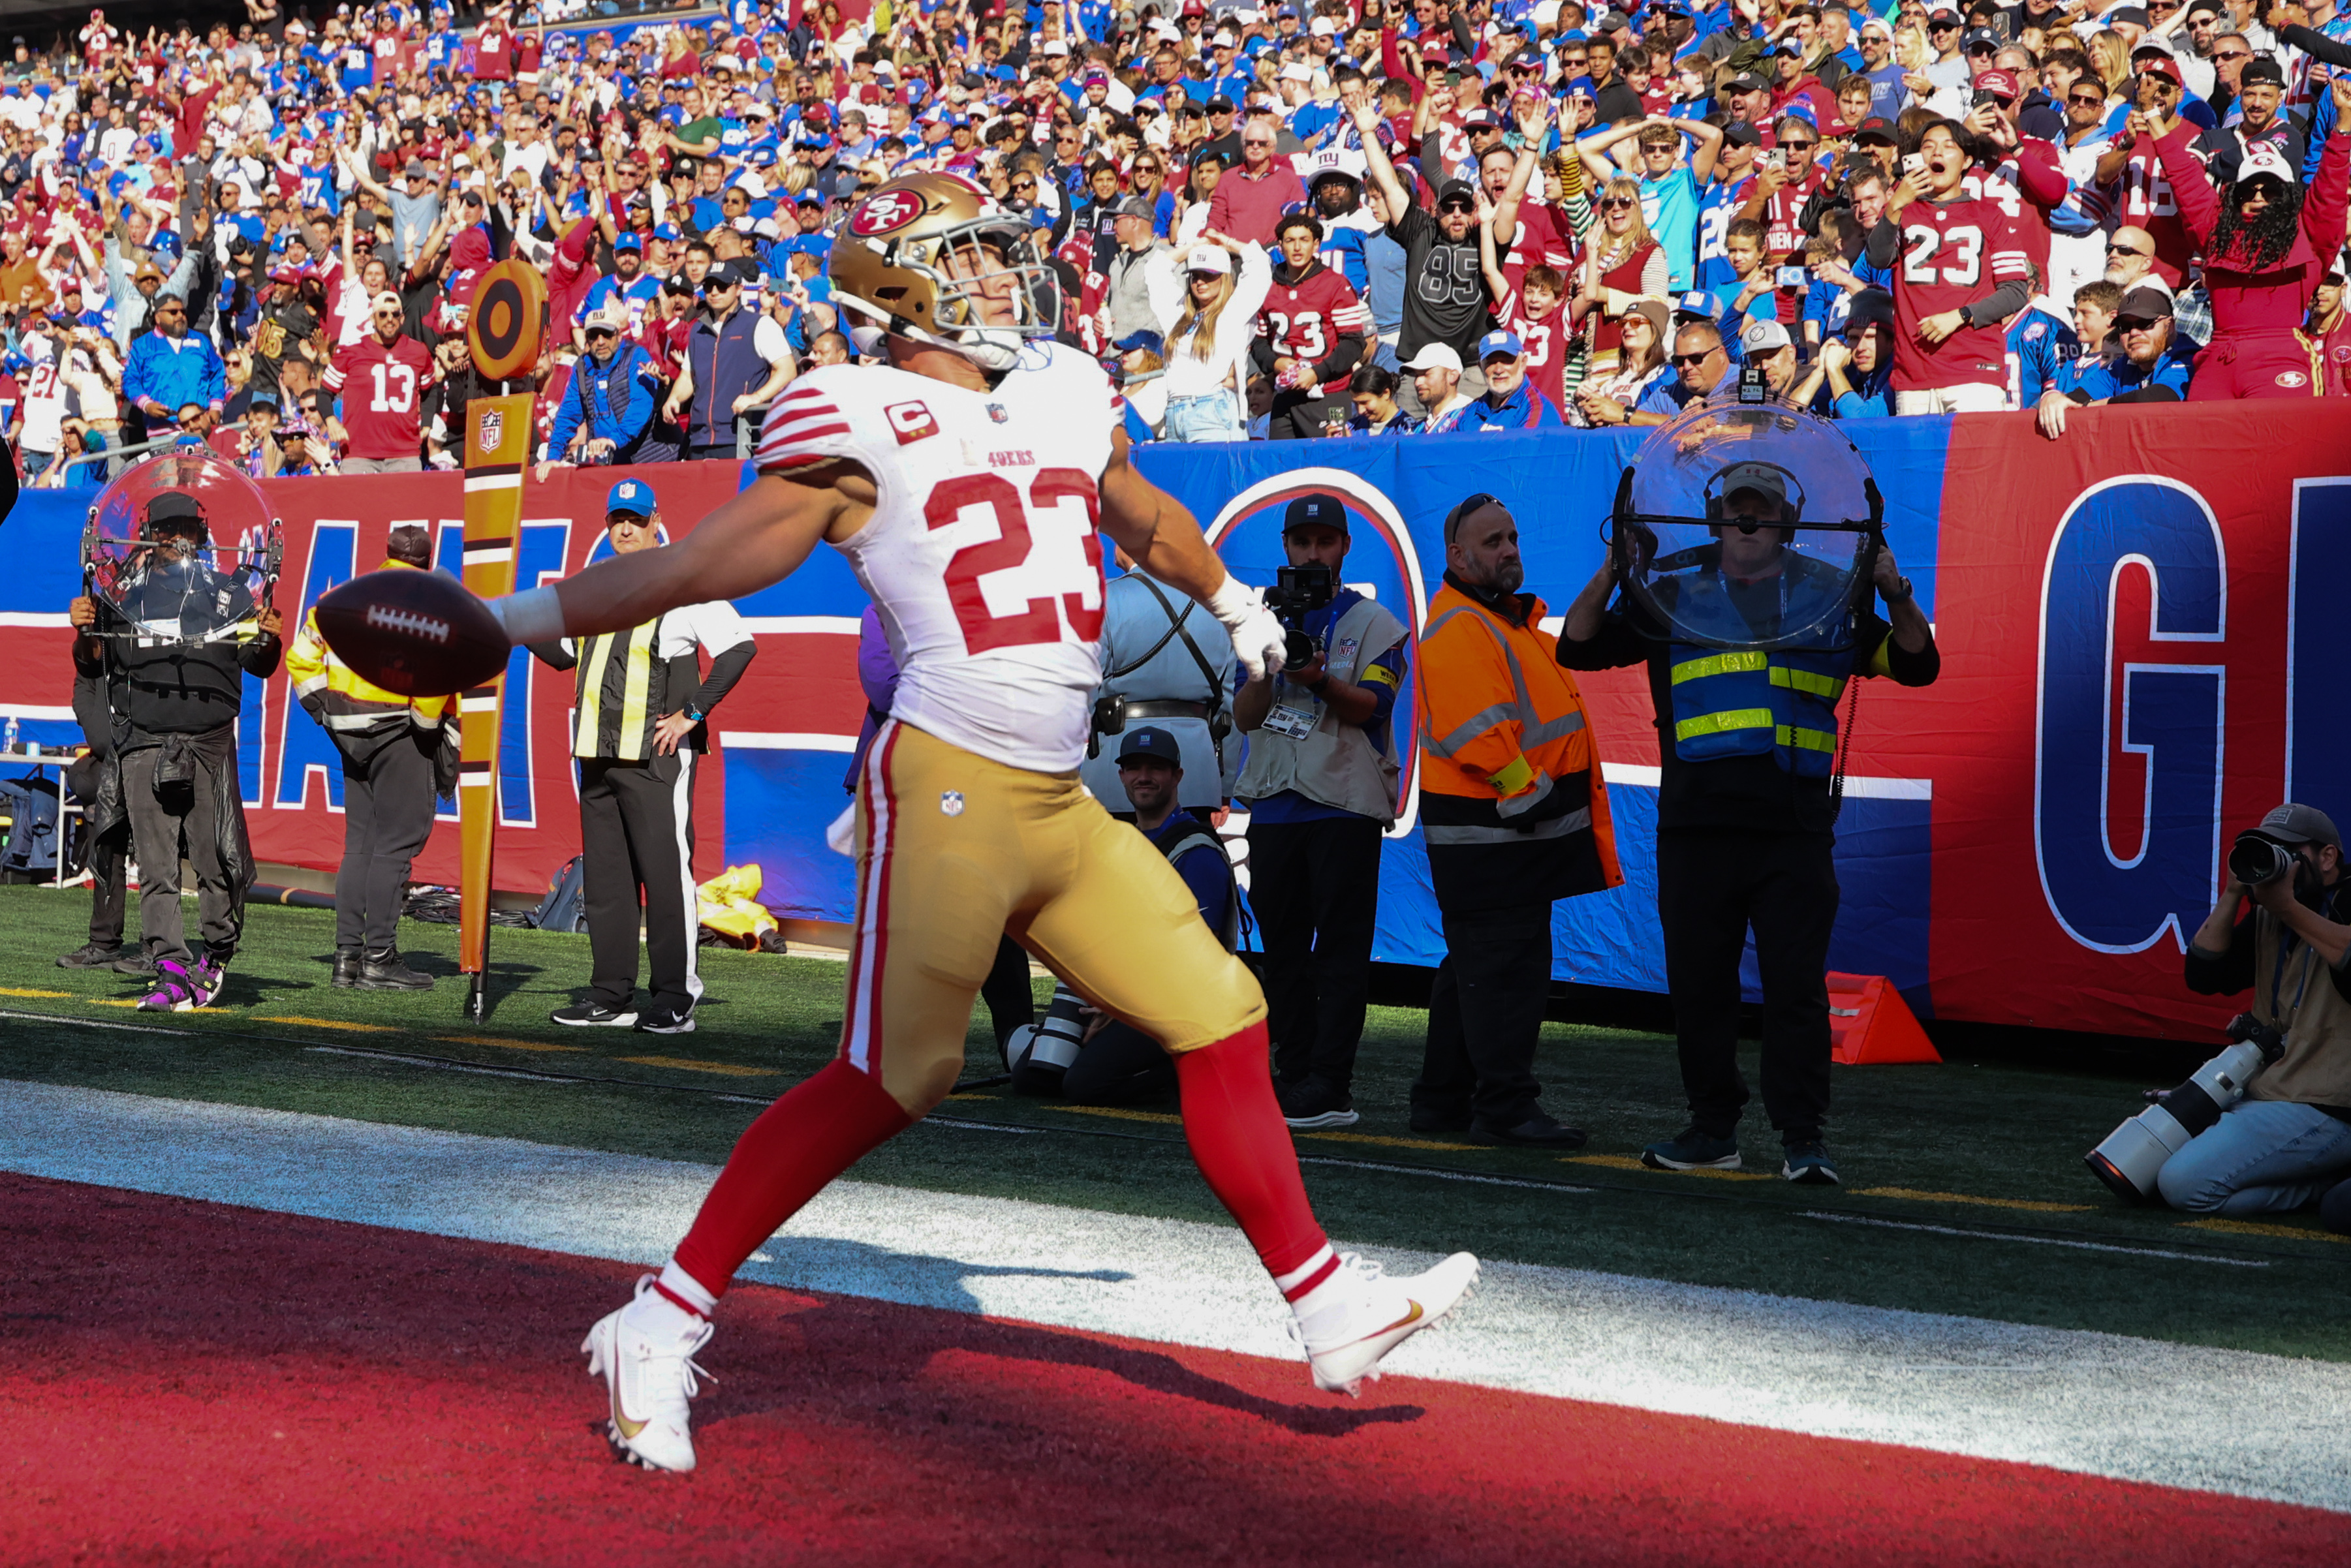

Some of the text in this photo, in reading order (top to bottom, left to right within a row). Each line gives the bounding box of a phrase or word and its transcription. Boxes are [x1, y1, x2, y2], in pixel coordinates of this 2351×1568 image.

[1904, 224, 1983, 287] 23
[1418, 245, 1483, 305] 85
[257, 320, 287, 360] 85
[1268, 311, 1326, 358] 23
[32, 366, 57, 399] 21
[370, 363, 415, 414] 13
[888, 401, 933, 434] C
[482, 428, 498, 446] NFL
[988, 450, 1036, 468] 49ERS
[923, 467, 1106, 656] 23
[1329, 660, 1354, 670] MEDIA
[1339, 645, 1356, 656] NFL
[944, 800, 962, 811] NFL
